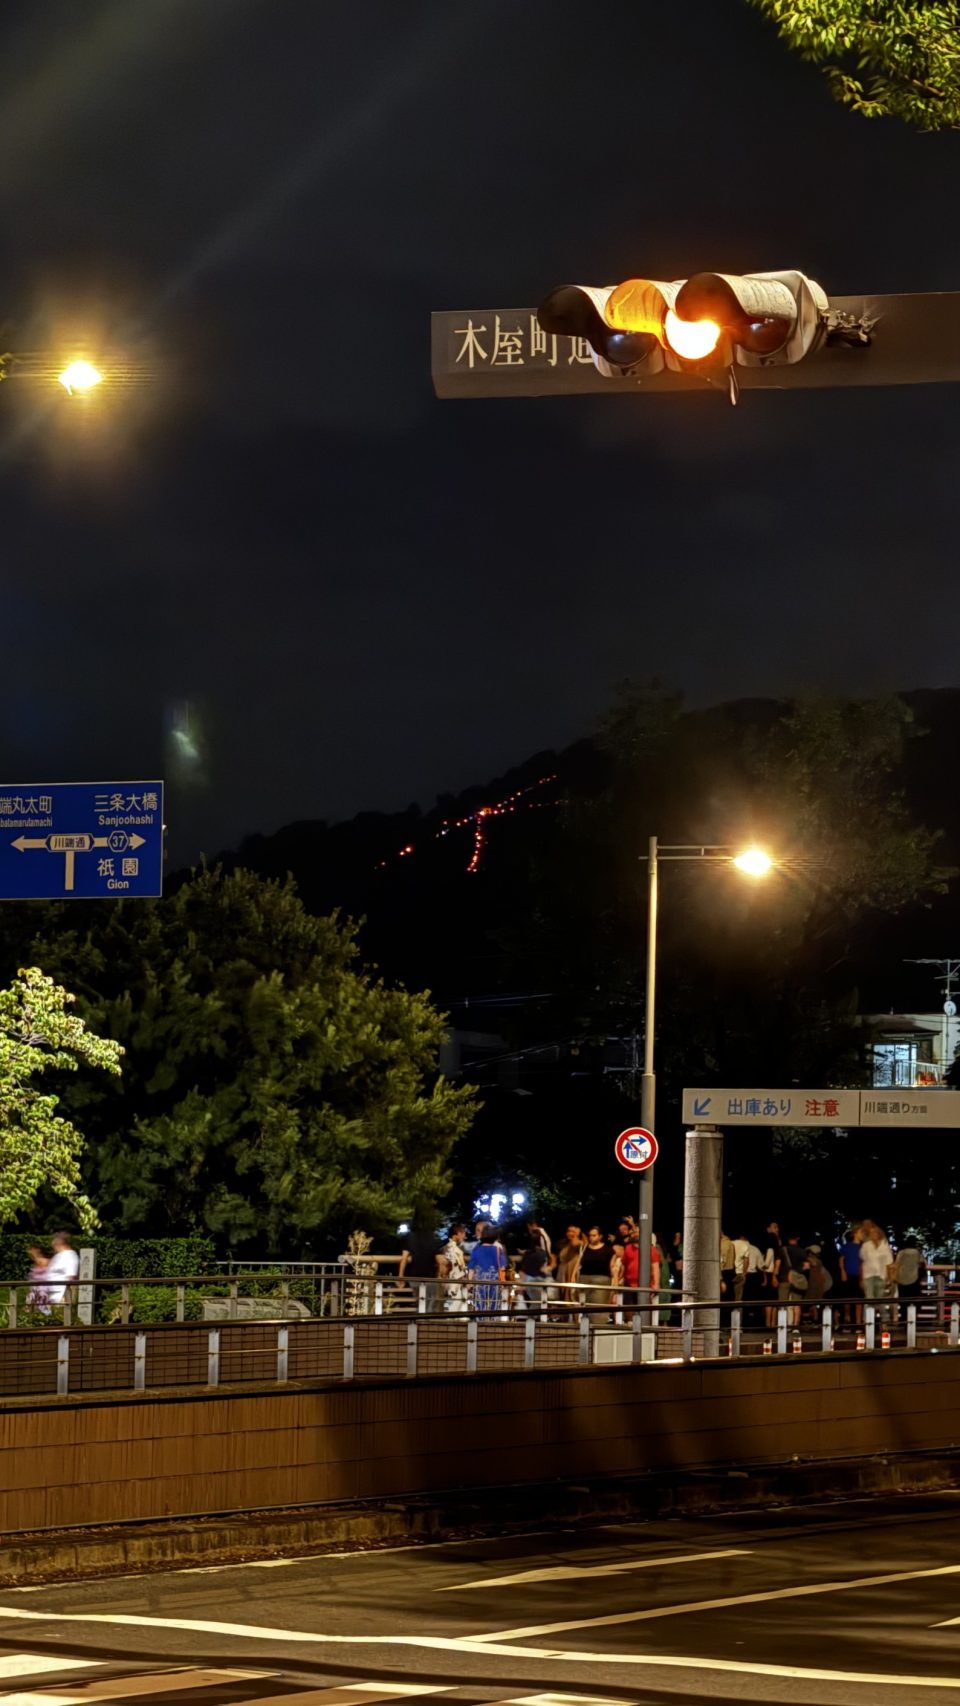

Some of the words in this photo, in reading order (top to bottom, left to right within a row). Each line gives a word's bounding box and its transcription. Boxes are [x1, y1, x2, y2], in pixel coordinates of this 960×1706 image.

[94, 792, 157, 812] 三条大橋
[98, 814, 153, 827] Sanjoohashi
[54, 836, 86, 848] 川端通
[112, 835, 124, 847] 37
[107, 879, 129, 889] Gion
[727, 1098, 792, 1117] 出庫あり
[804, 1099, 840, 1117] 注意
